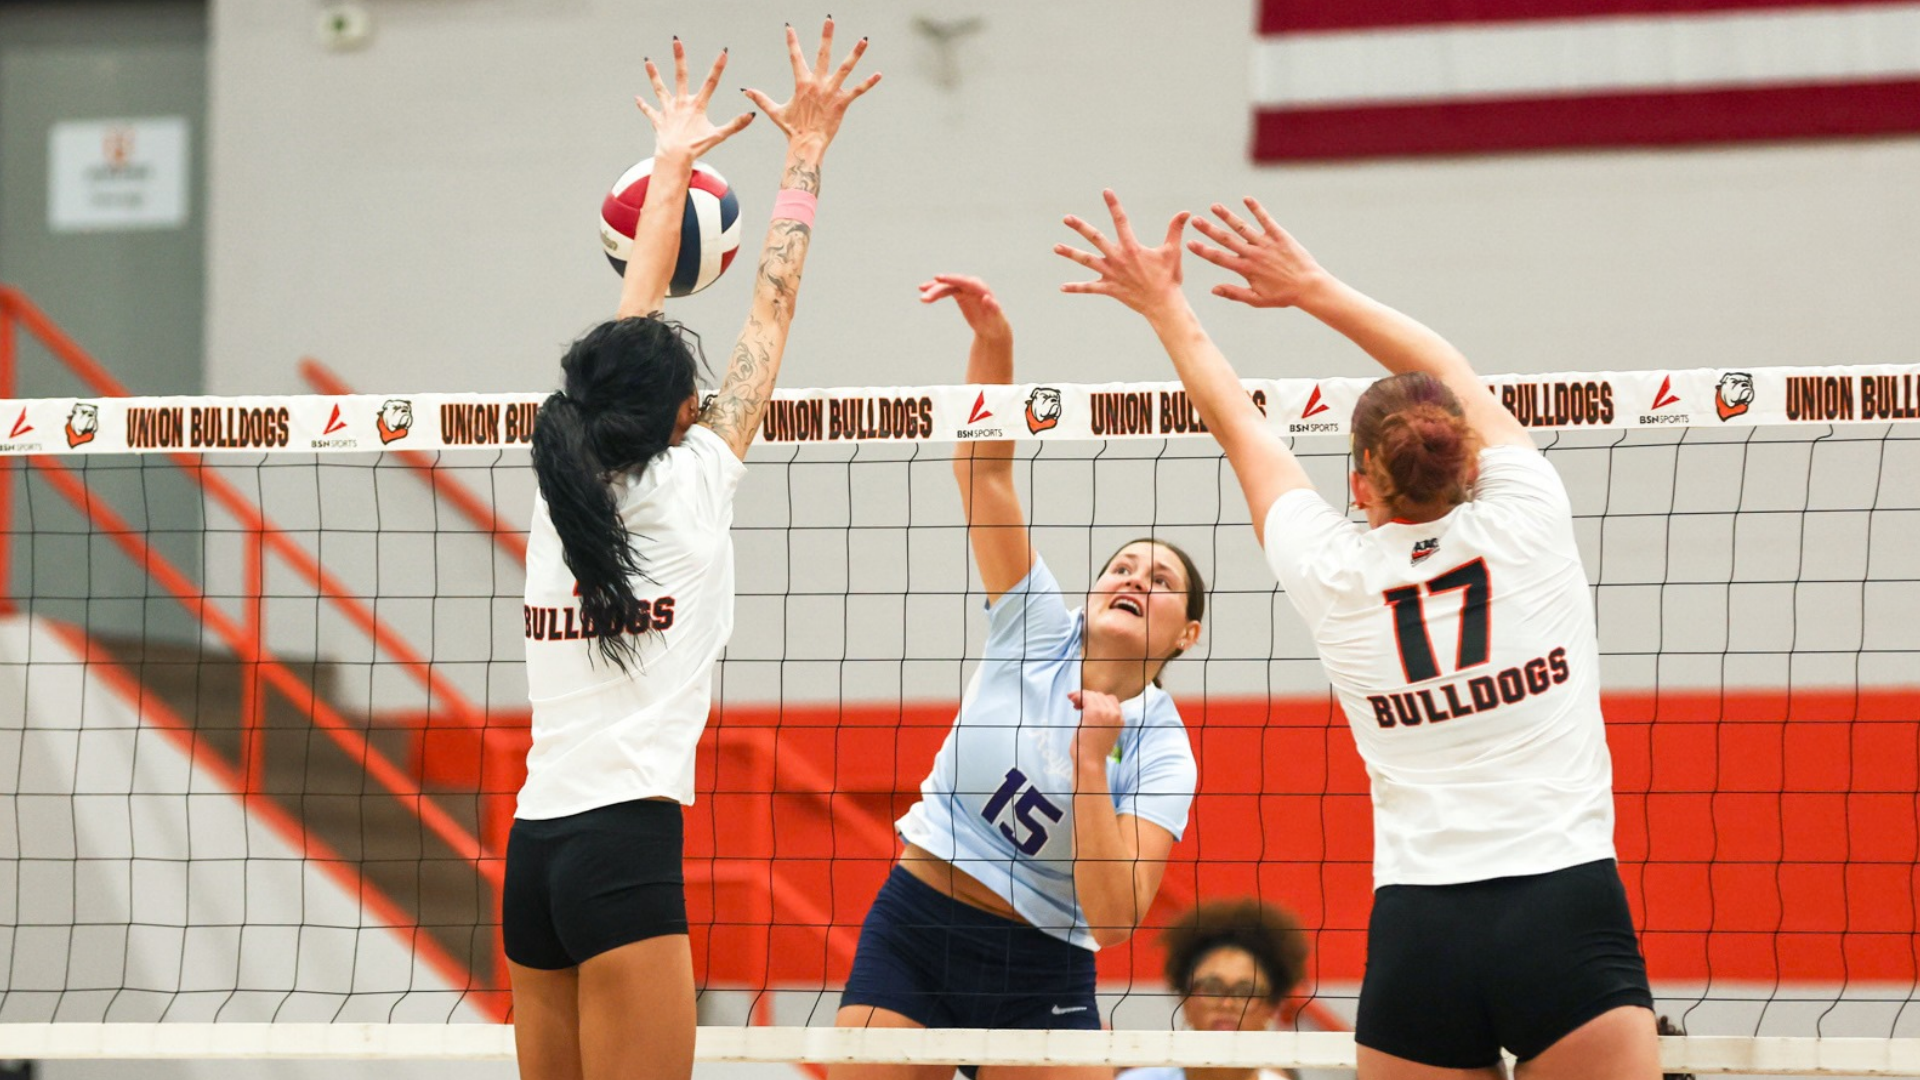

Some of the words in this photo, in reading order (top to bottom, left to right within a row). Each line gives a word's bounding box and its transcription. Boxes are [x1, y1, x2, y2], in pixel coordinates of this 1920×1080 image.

[1090, 391, 1153, 435] UNION
[1501, 381, 1615, 427] BULLDOGS
[1640, 415, 1659, 424] BSN
[1660, 414, 1689, 424] SPORTS
[1786, 376, 1854, 420] UNION
[1861, 374, 1920, 420] BULL
[127, 407, 183, 448] UNION
[190, 406, 289, 447] BULLDOGS
[440, 403, 500, 445] UNION
[763, 399, 824, 442] UNION
[828, 397, 932, 440] BULLDOGS
[957, 430, 973, 438] BSN
[974, 429, 1003, 438] SPORTS
[1289, 424, 1309, 432] BSN
[1310, 423, 1338, 432] SPORTS
[311, 440, 330, 448] BSN
[331, 439, 358, 448] SPORTS
[1382, 556, 1493, 684] 17
[1366, 646, 1570, 728] BULLDOGS
[981, 768, 1064, 857] 15
